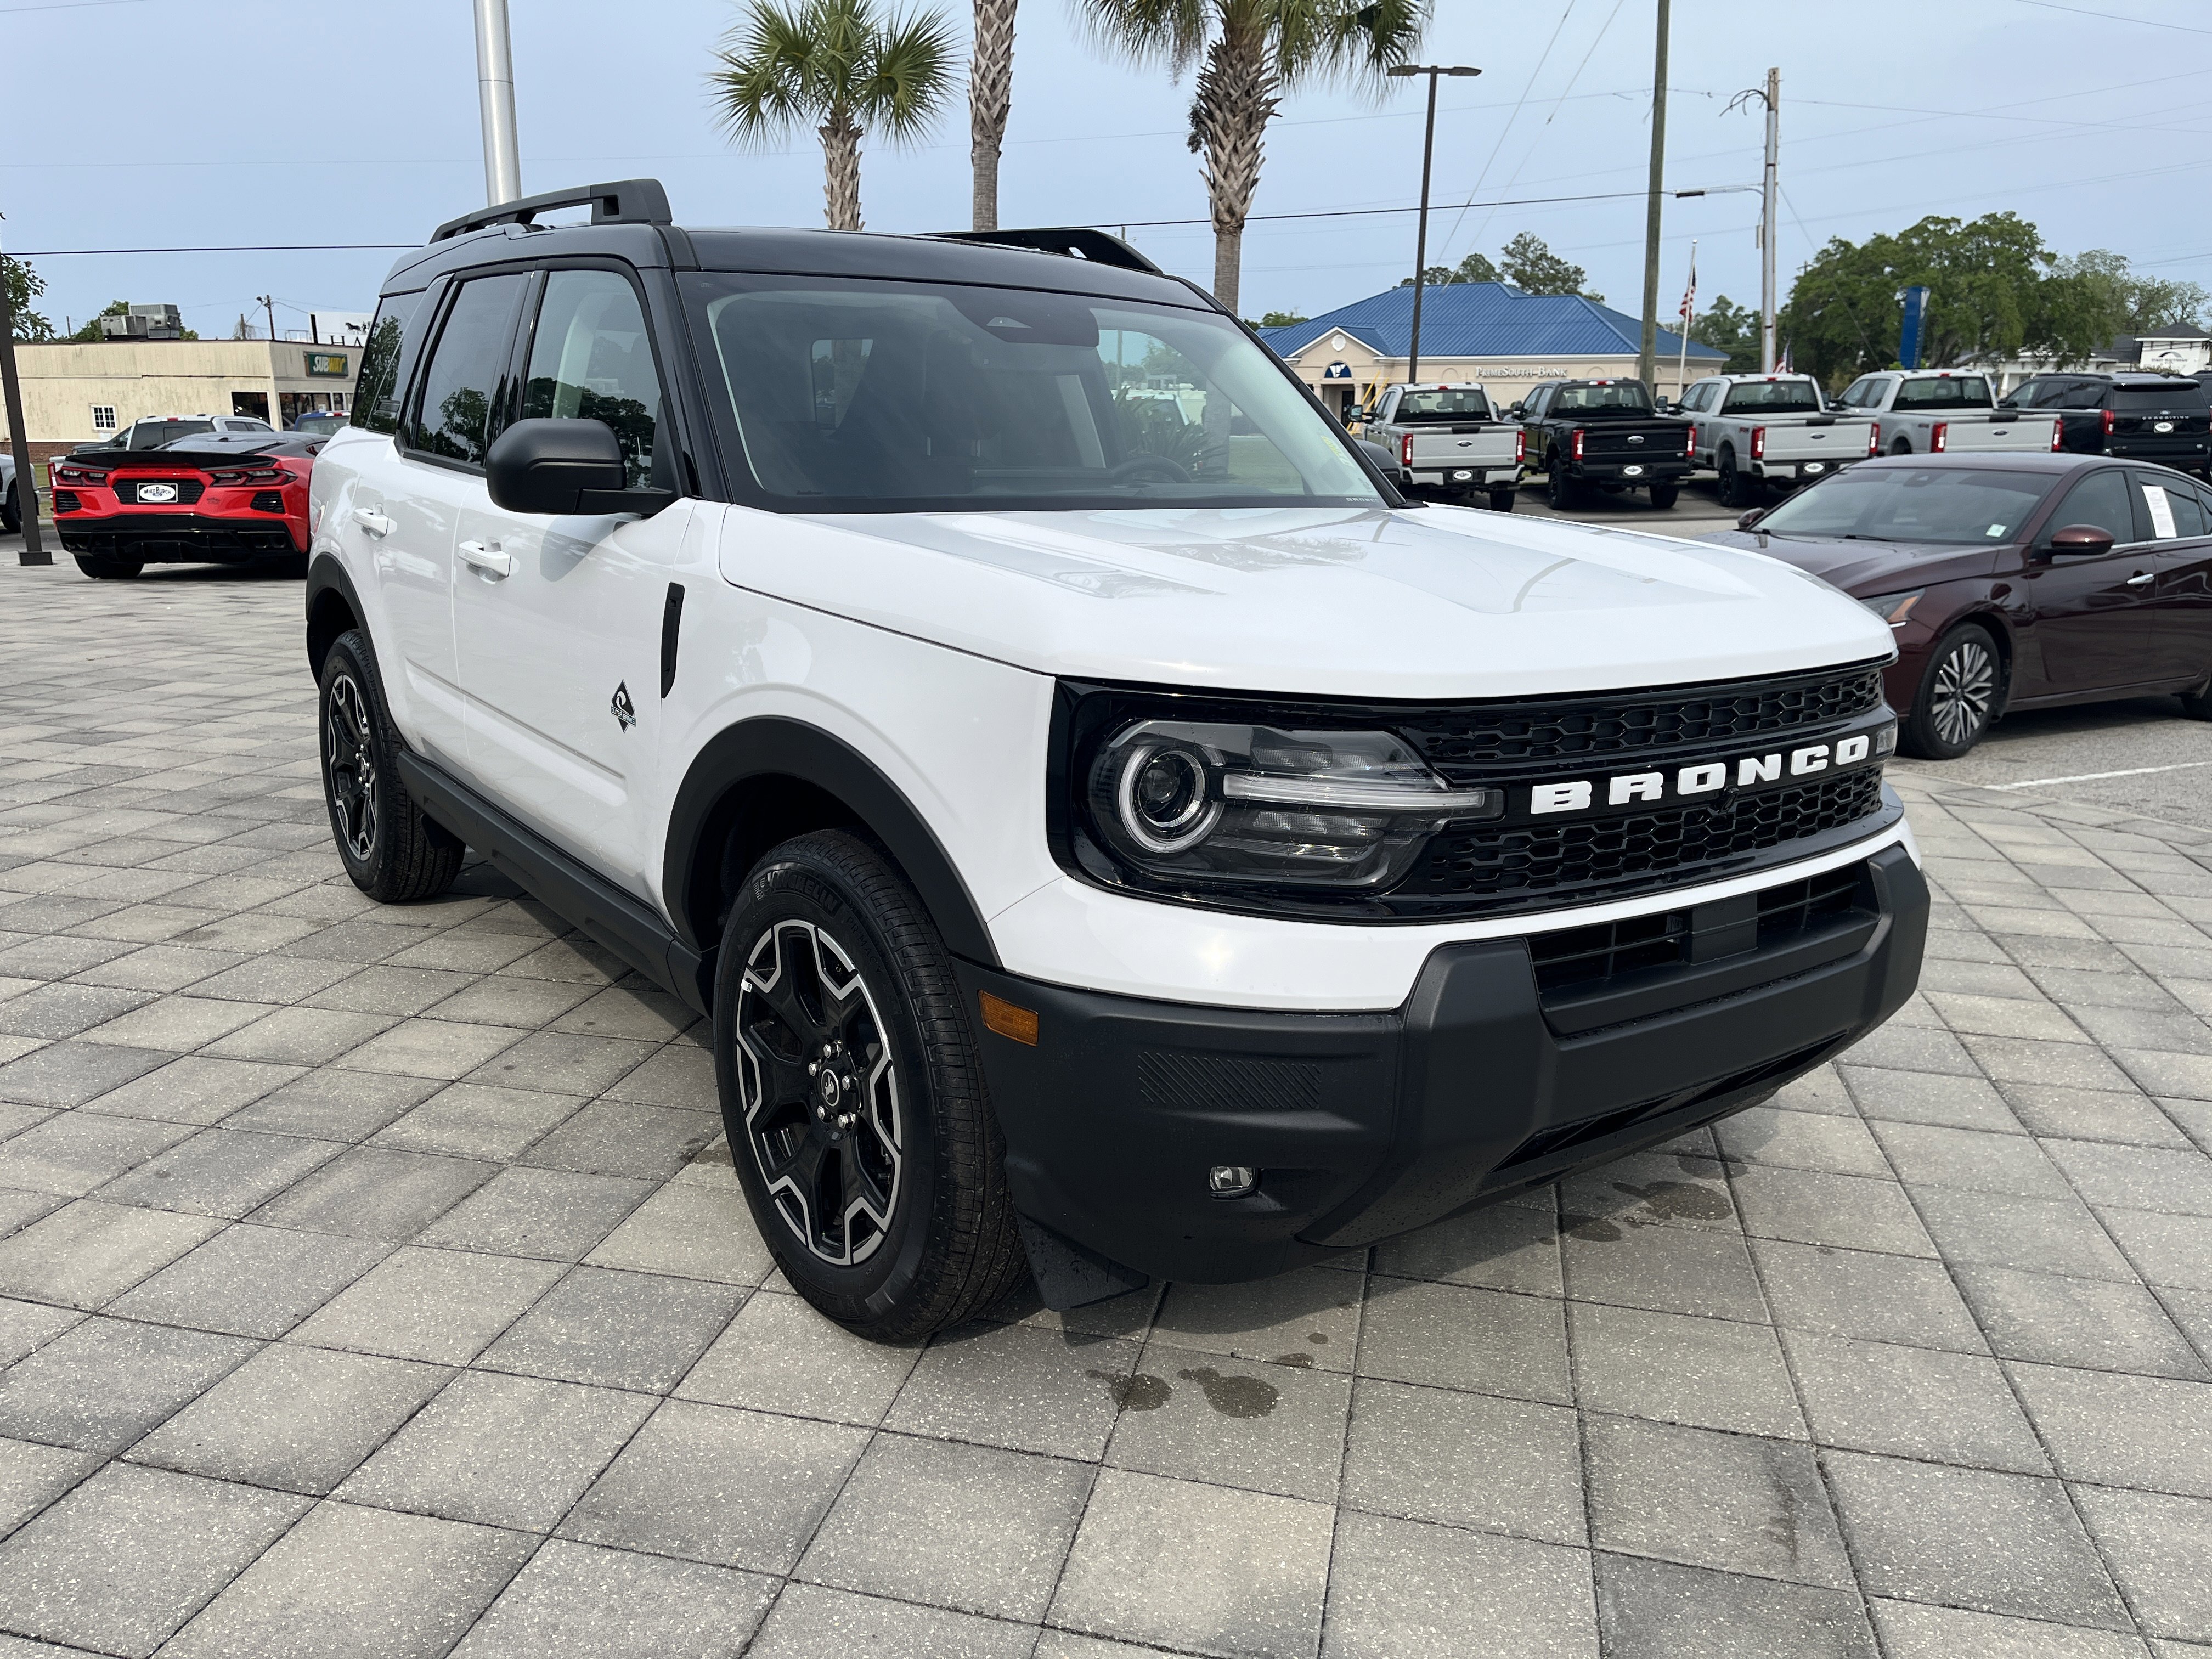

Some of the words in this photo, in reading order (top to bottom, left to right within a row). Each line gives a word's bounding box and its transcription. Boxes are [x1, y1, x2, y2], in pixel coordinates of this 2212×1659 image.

[313, 356, 346, 373] SUBWAY
[611, 707, 623, 719] OUTER
[1531, 735, 1869, 815] BRONCO
[772, 869, 838, 912] MICHELIN
